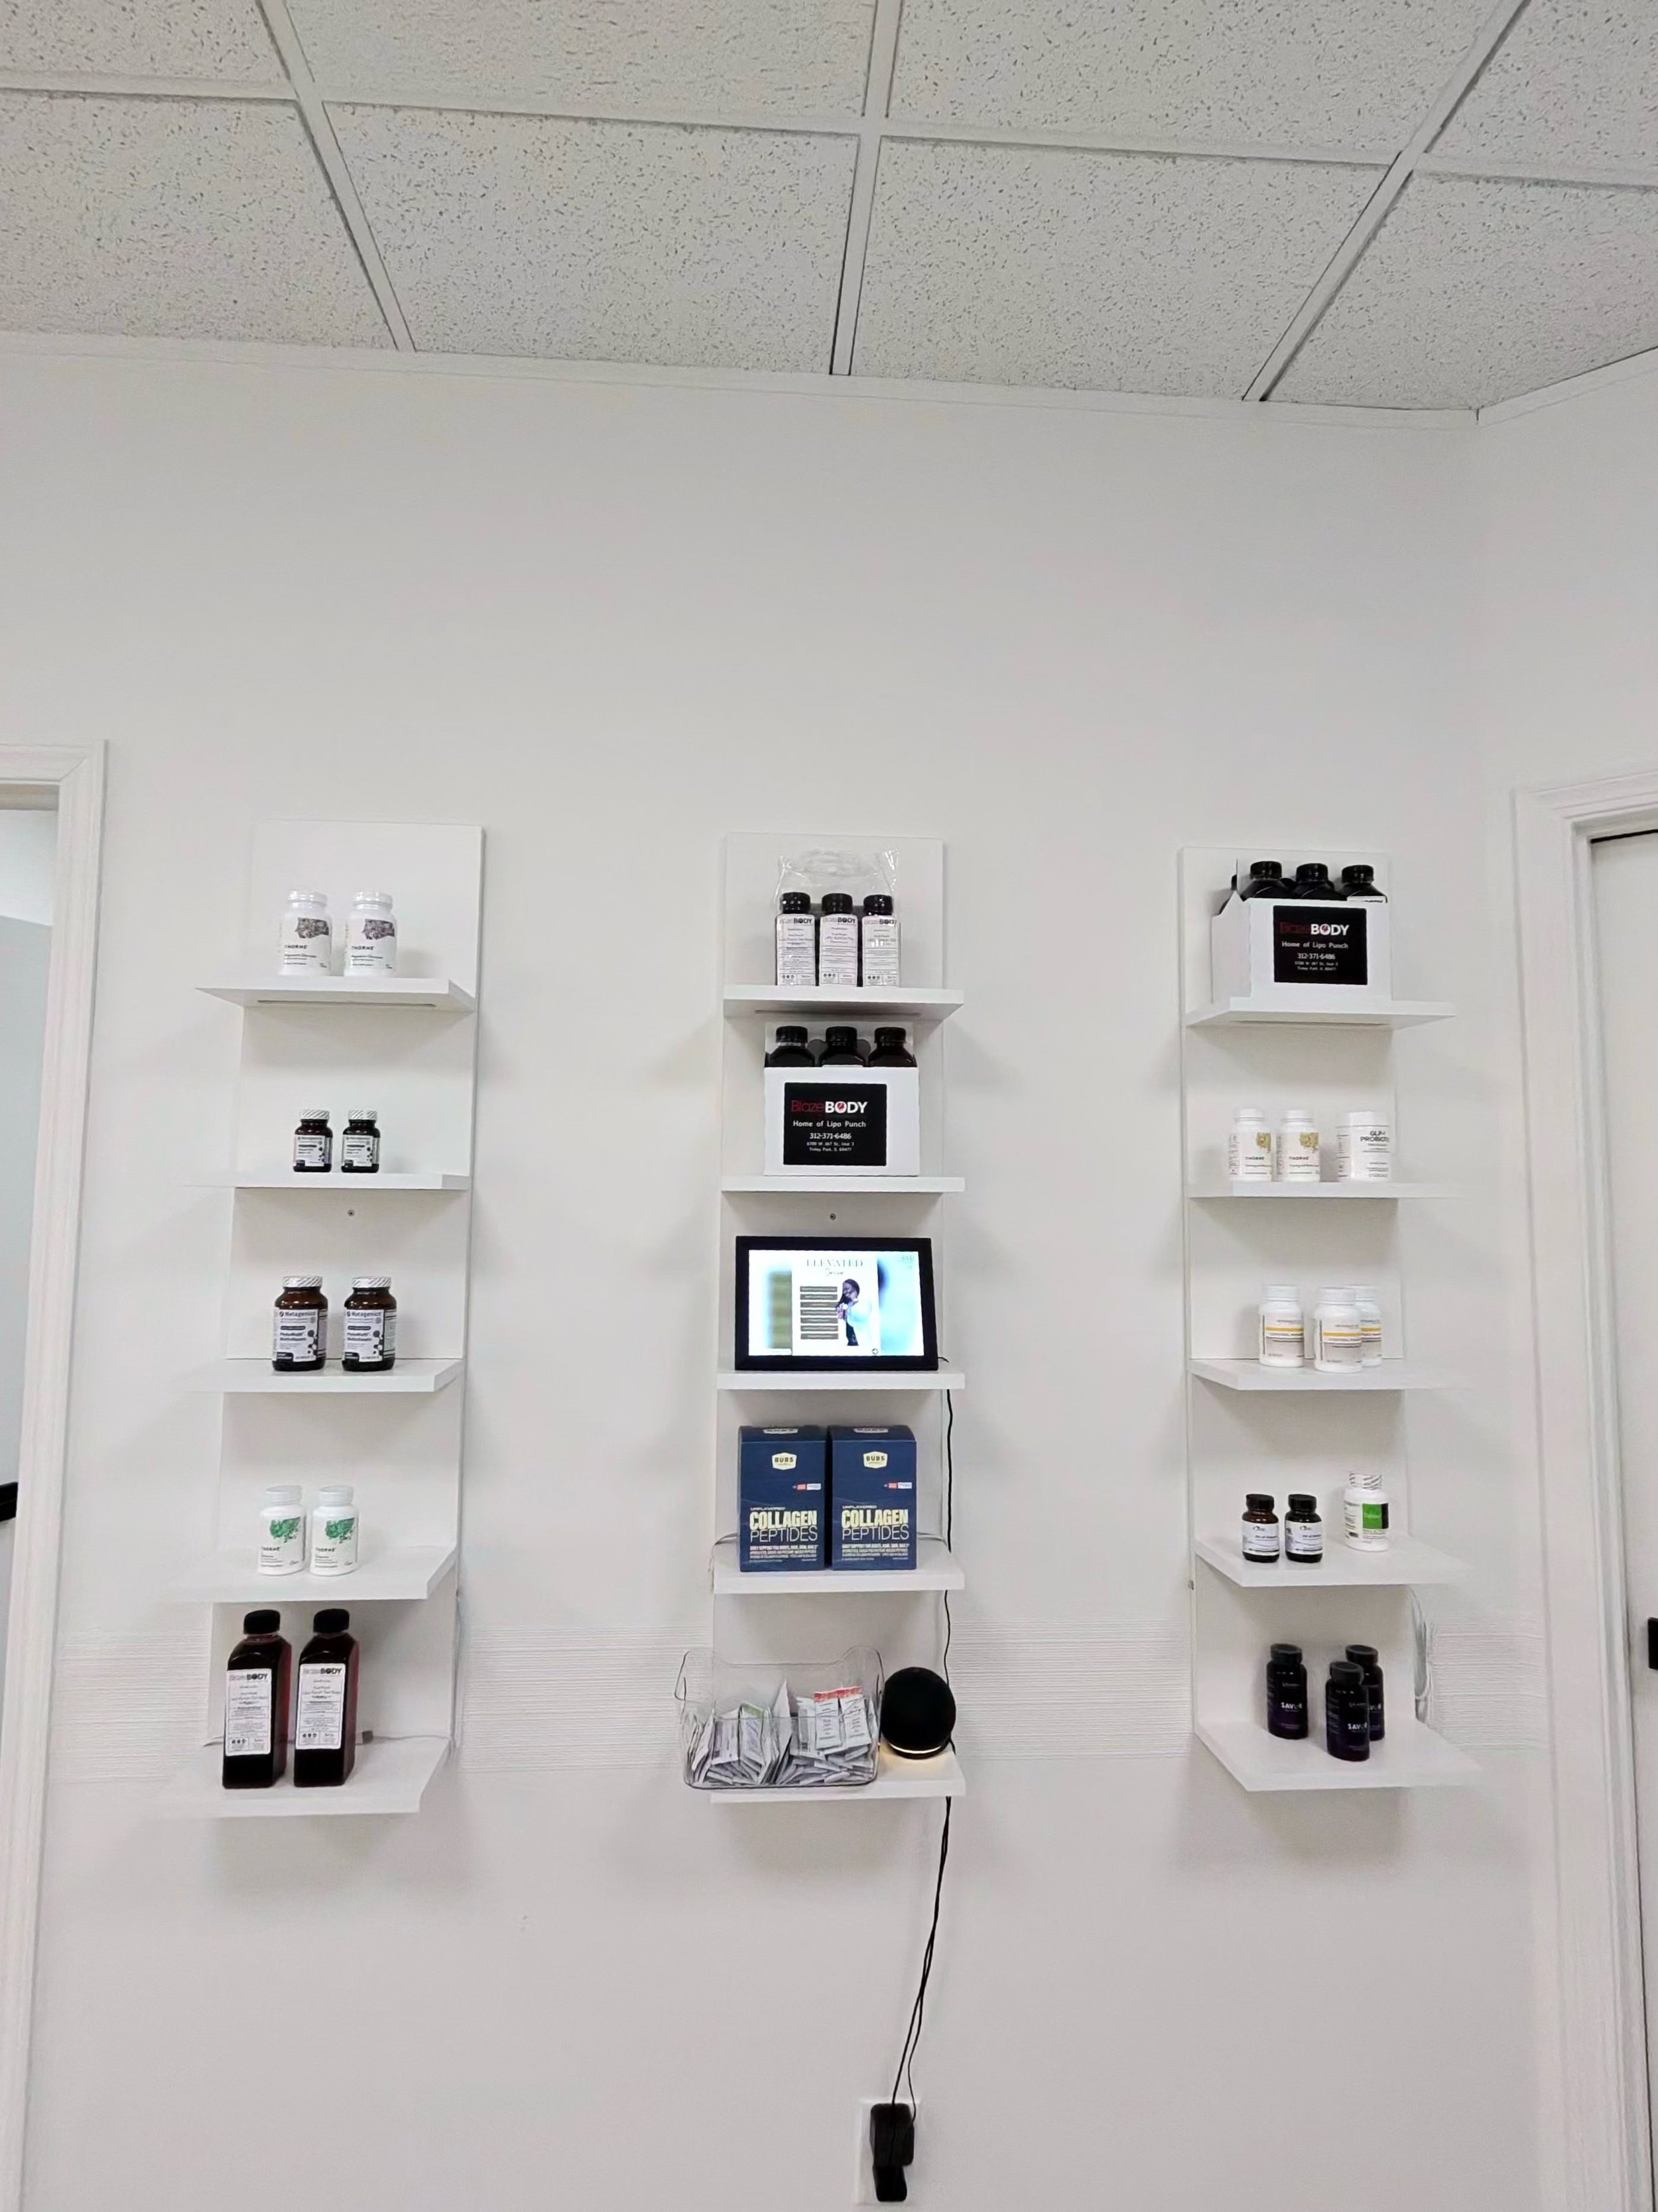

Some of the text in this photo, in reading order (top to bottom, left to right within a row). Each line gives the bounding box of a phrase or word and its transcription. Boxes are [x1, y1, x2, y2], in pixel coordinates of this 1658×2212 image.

[749, 1510, 817, 1530] COLLAGEN
[842, 1509, 909, 1528] COLLAGEN
[750, 1525, 818, 1542] PEPTIDES
[842, 1524, 909, 1540] PEPTIDES
